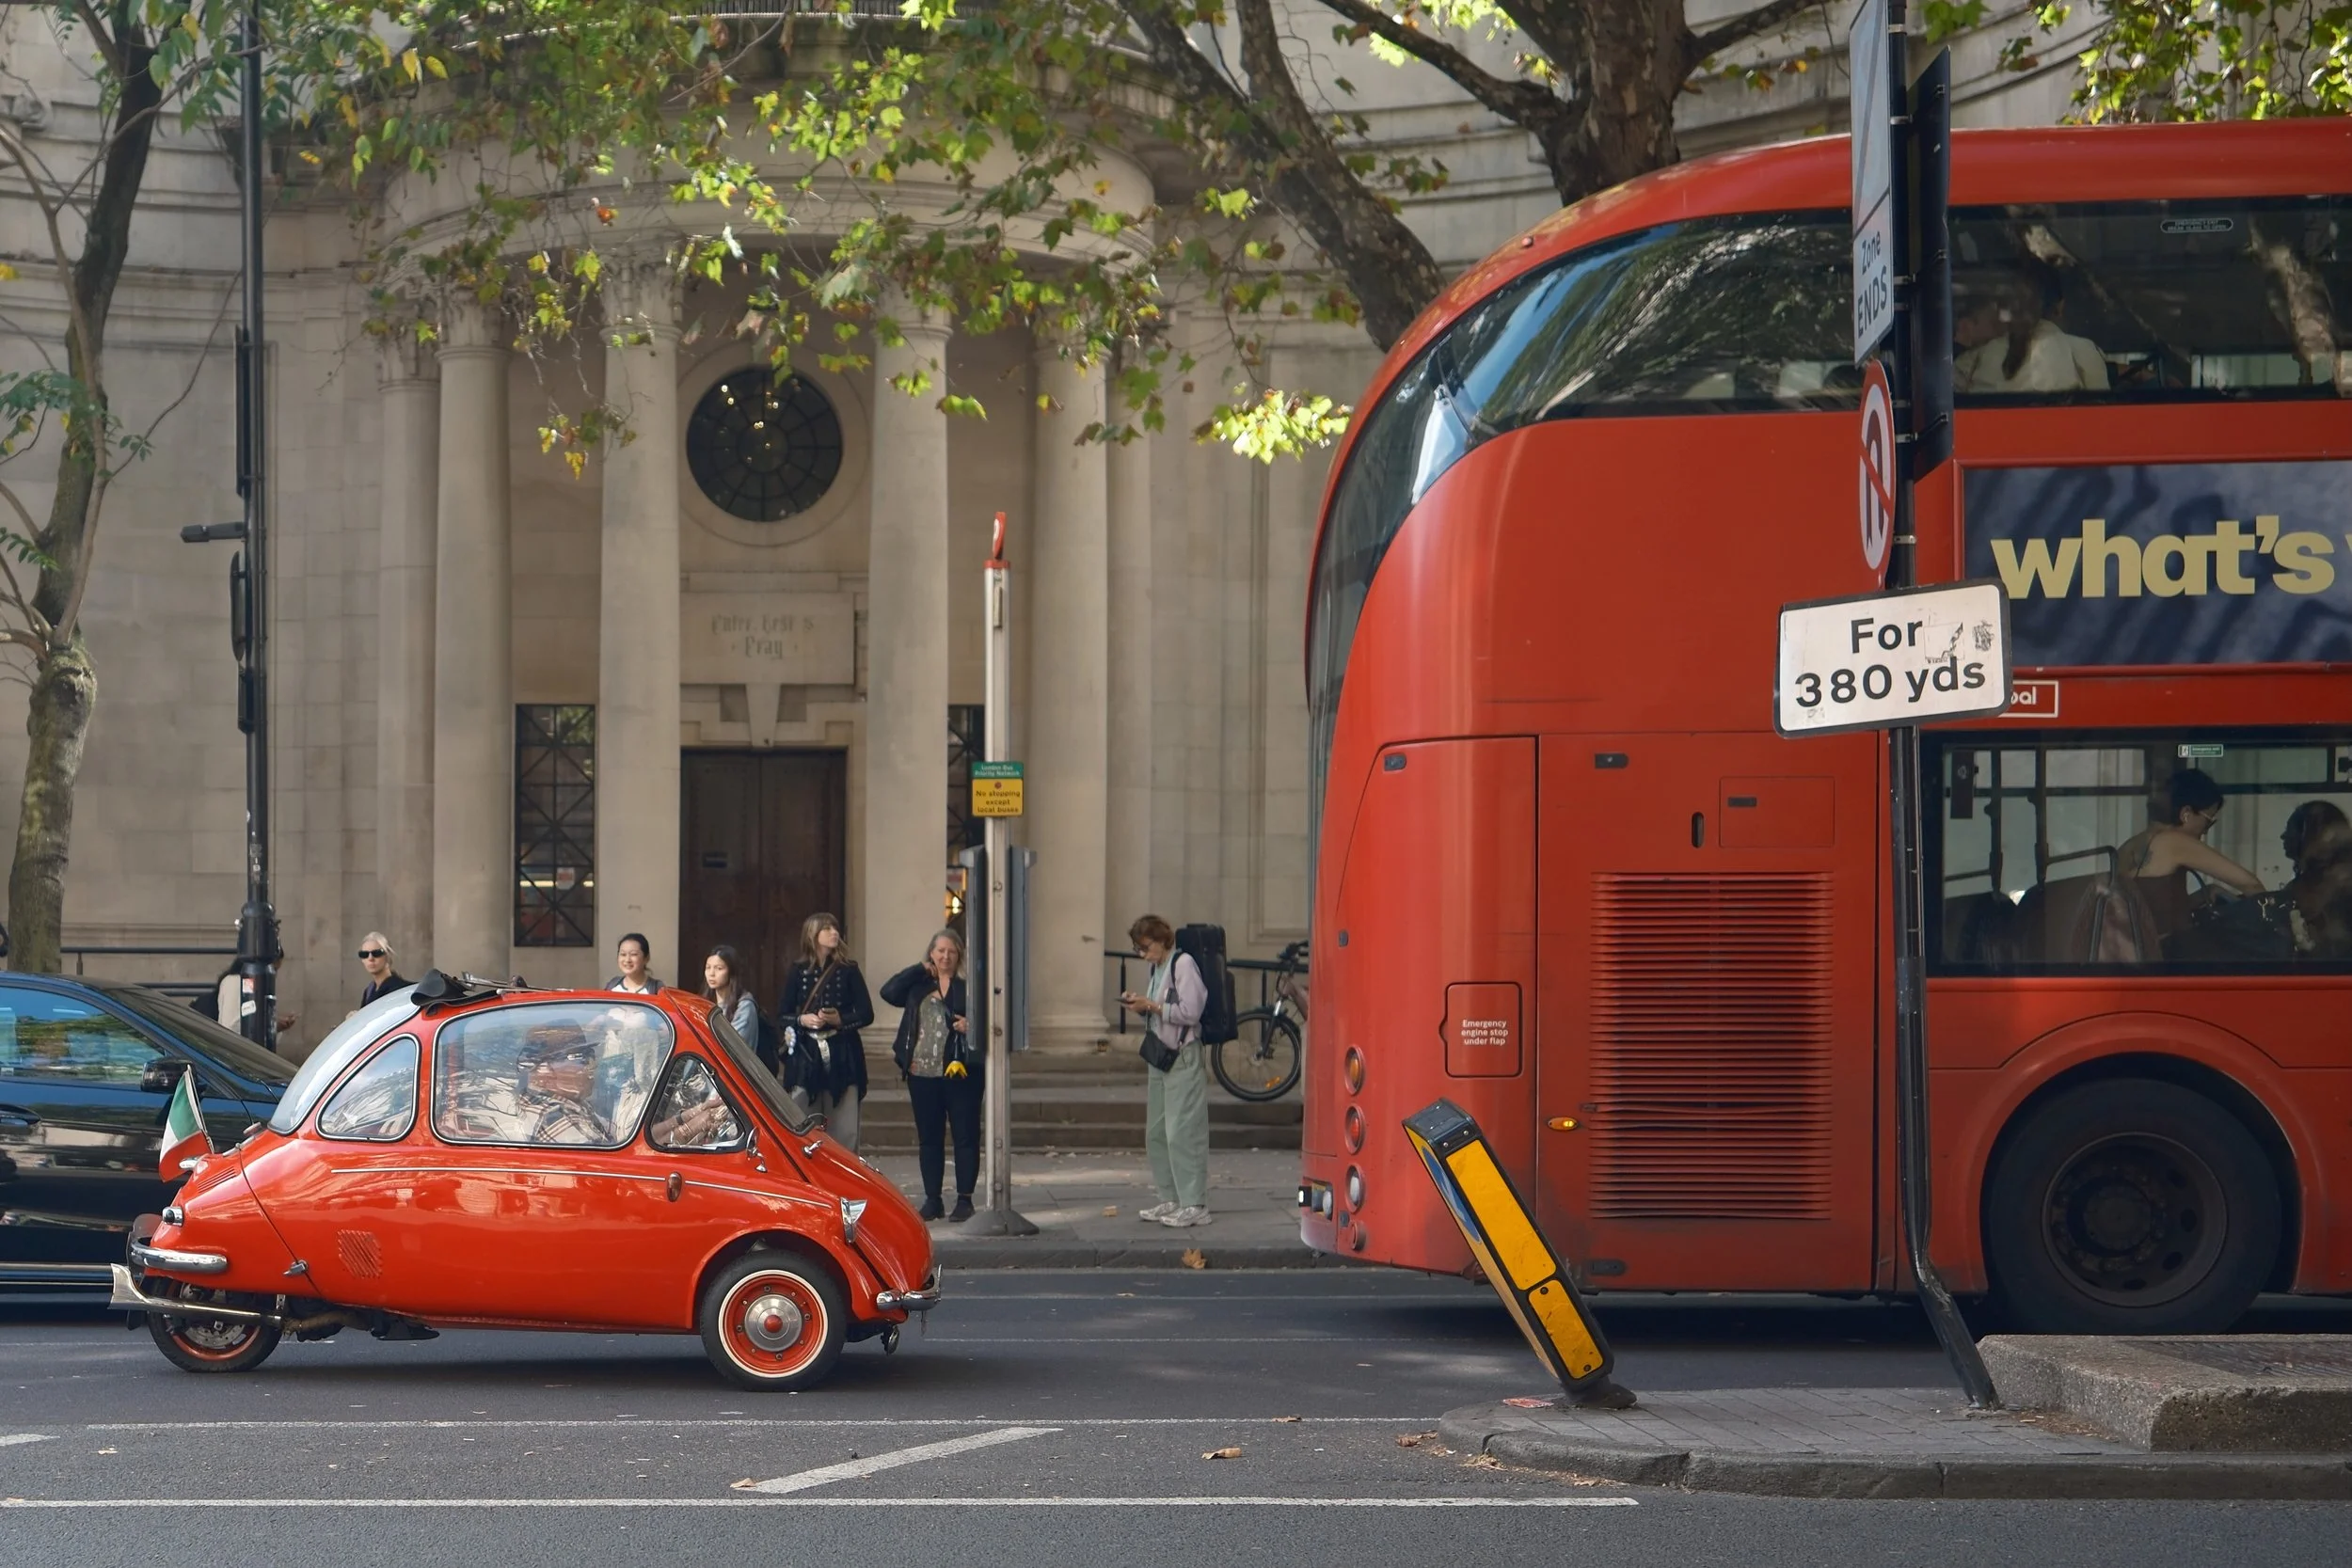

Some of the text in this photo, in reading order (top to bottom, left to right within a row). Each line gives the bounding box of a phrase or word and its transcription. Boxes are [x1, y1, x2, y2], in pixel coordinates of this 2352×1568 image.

[1862, 231, 1881, 275] Zone
[1858, 265, 1887, 339] ENDS
[1990, 515, 2335, 599] what’s
[745, 636, 783, 660] Pray
[1851, 617, 1923, 654] For
[1795, 656, 1985, 707] 380 yds
[1461, 1029, 1488, 1037] engine
[1462, 1019, 1506, 1028] Emergency
[1464, 1037, 1505, 1046] under flap
